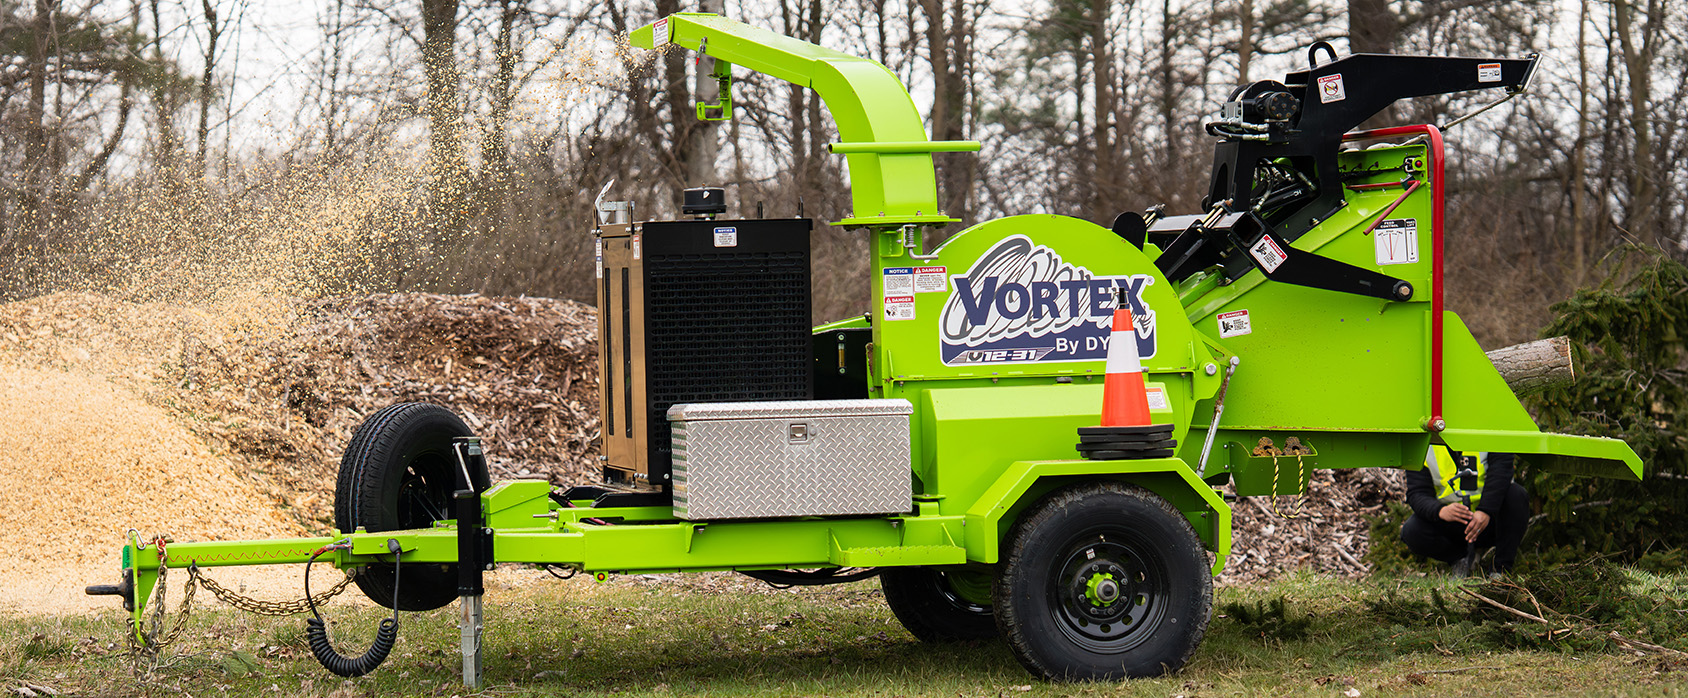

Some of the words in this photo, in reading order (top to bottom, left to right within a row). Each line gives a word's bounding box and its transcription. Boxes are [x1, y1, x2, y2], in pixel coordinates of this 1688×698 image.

[954, 276, 1147, 326] VORTEX
[1056, 337, 1079, 354] By
[1085, 336, 1111, 351] DY
[966, 349, 1037, 362] V12-31
